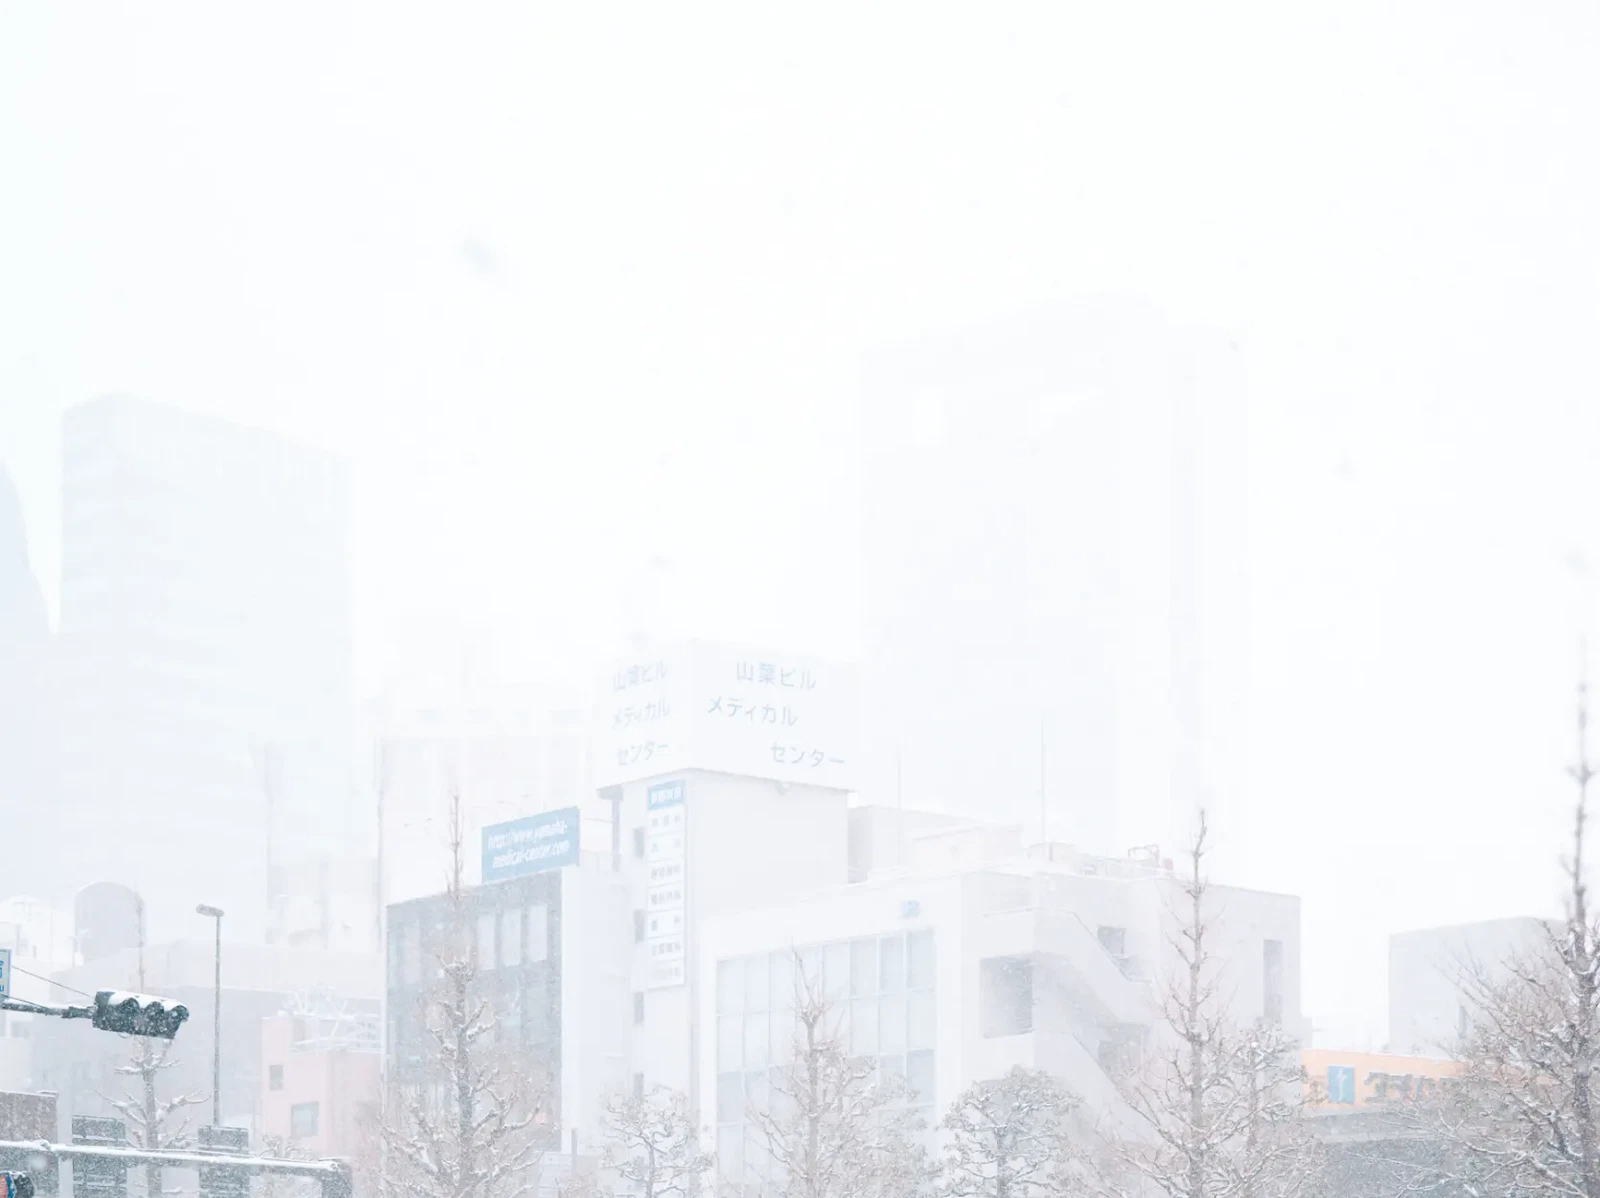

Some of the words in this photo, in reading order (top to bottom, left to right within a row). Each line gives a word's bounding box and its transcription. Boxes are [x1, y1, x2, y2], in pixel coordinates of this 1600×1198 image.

[738, 660, 817, 690] 山葉ビル
[613, 697, 670, 730] メディカル
[708, 698, 798, 727] メディカル
[618, 741, 669, 766] センター
[770, 742, 844, 767] センター
